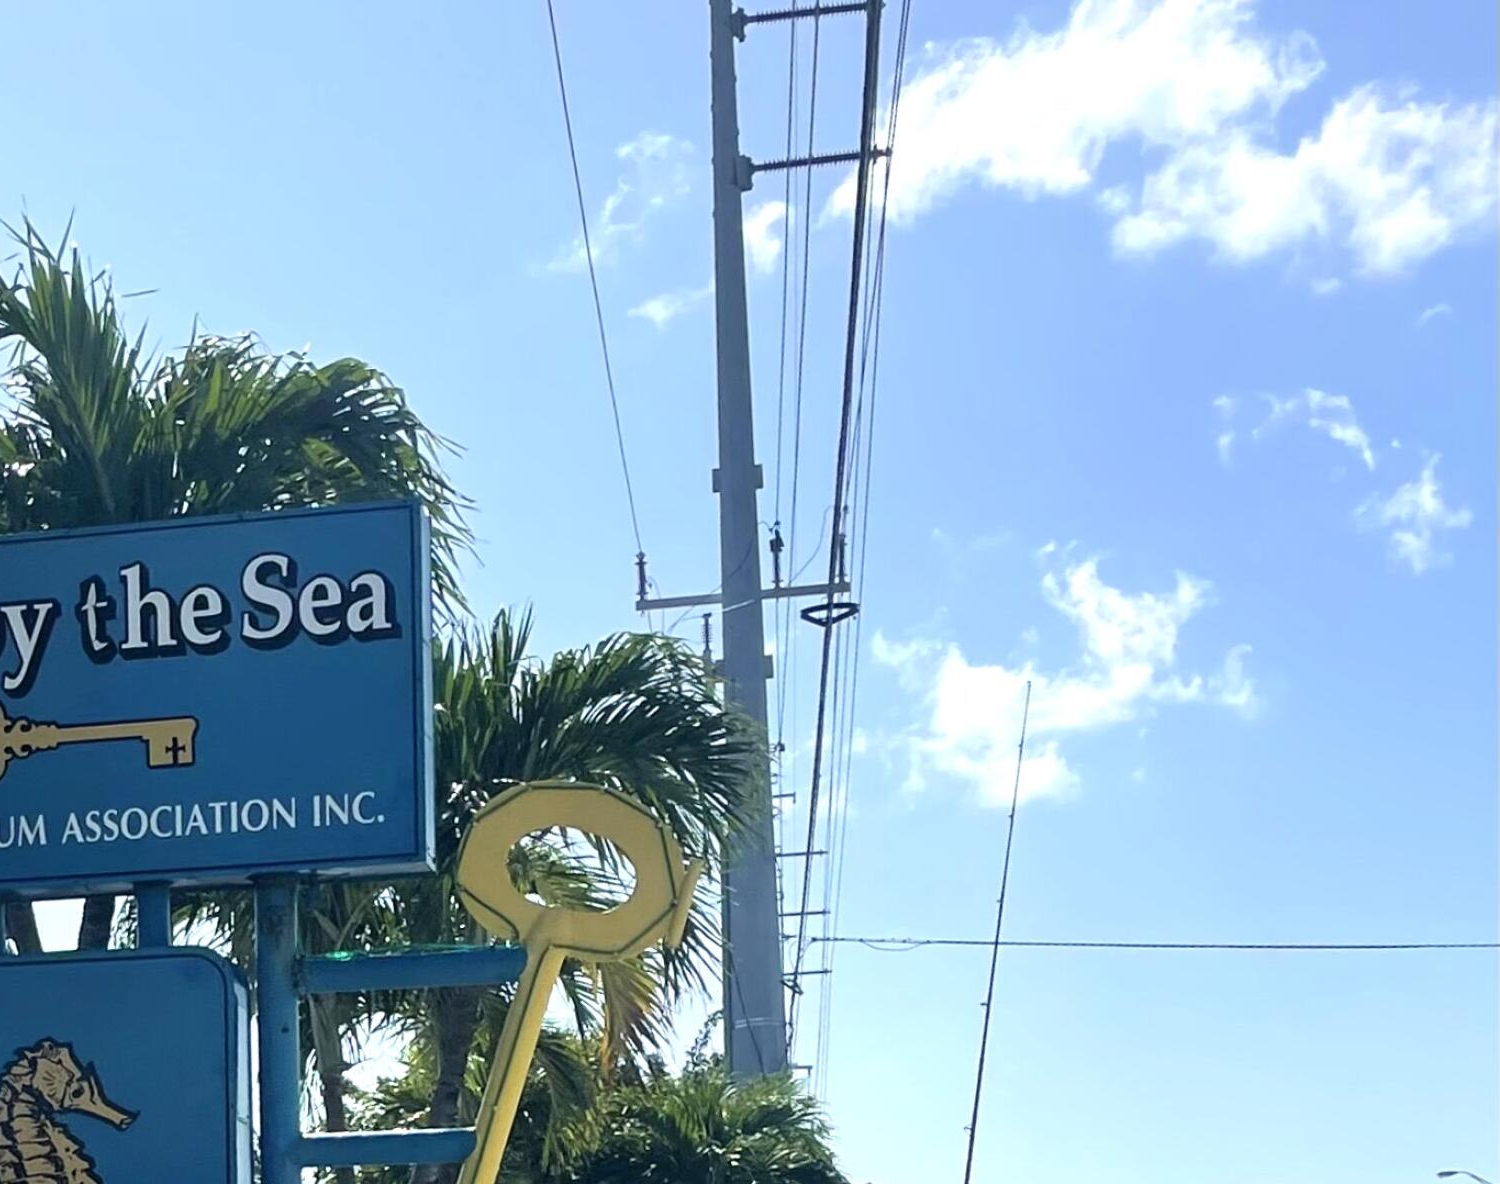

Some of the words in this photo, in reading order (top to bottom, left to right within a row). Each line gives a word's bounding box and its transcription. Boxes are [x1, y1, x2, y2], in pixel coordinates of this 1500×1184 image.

[81, 563, 223, 652] the
[241, 554, 393, 640] Sea
[61, 797, 296, 845] ASSOCIATION
[313, 791, 385, 828] INC.
